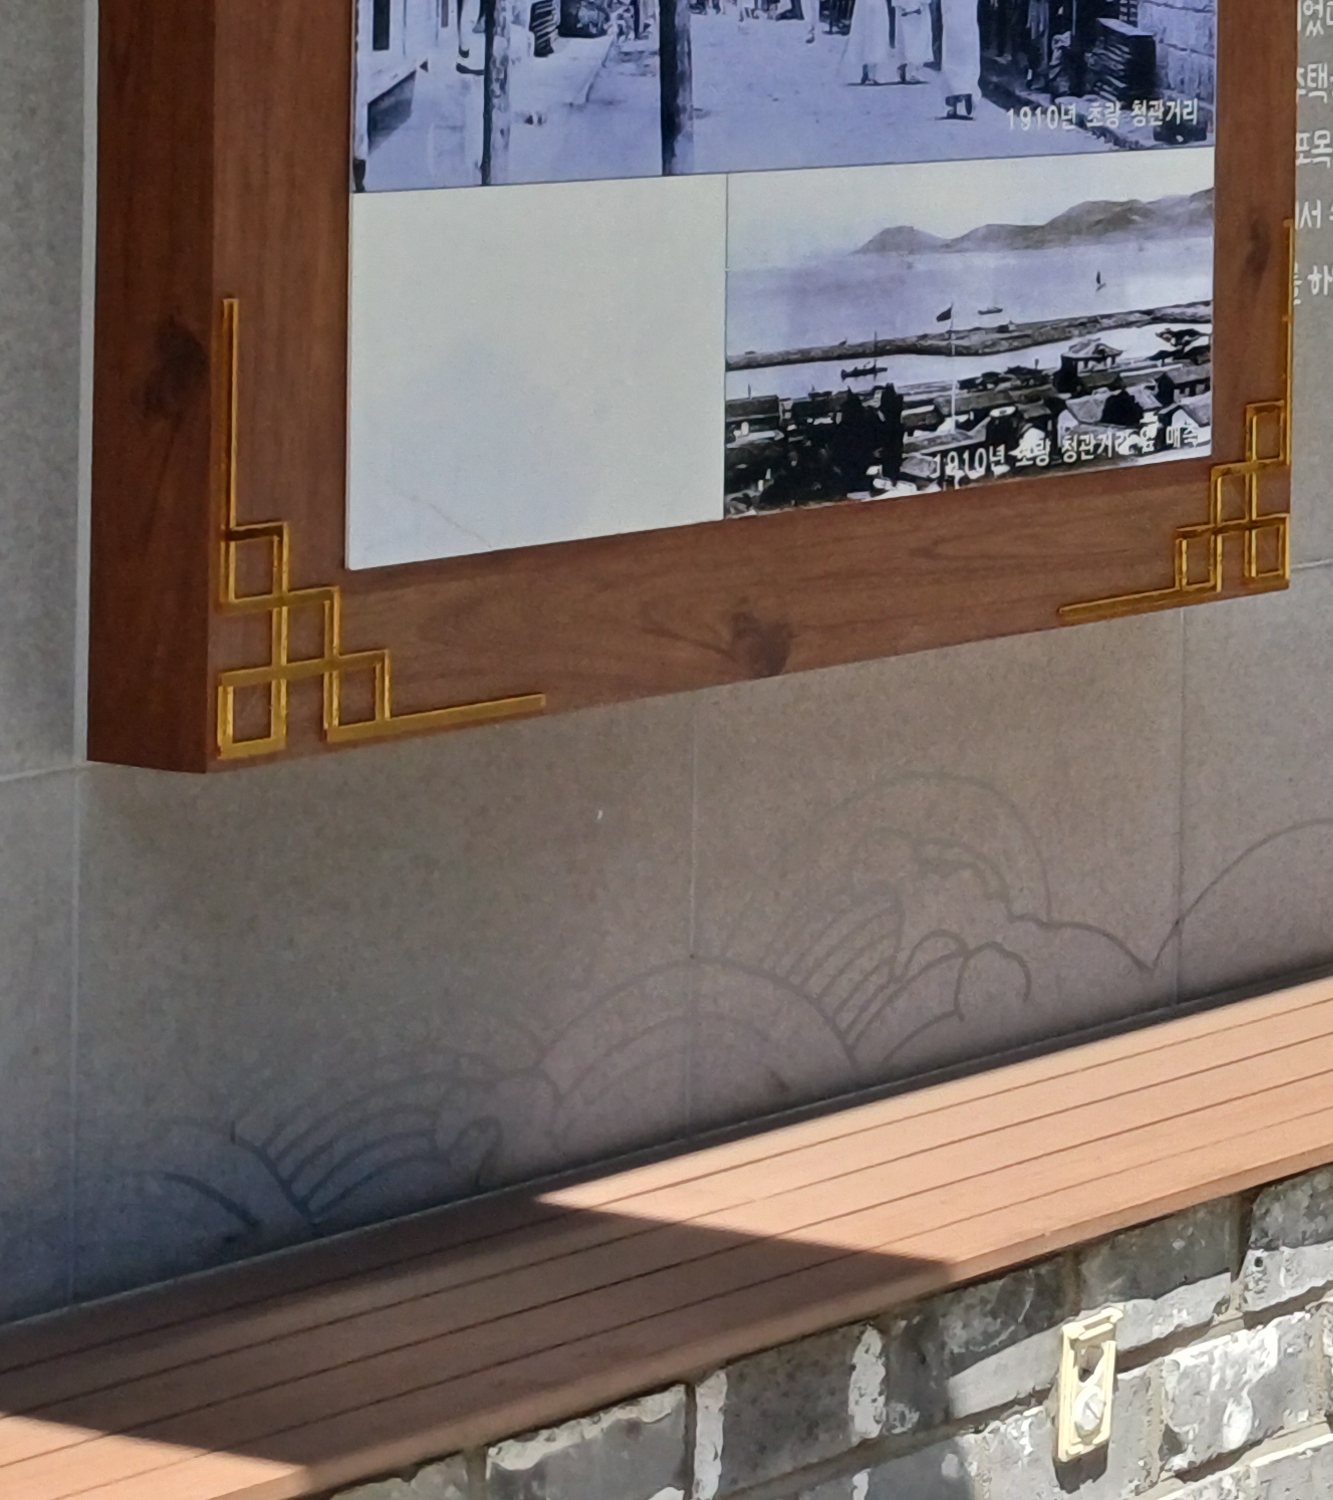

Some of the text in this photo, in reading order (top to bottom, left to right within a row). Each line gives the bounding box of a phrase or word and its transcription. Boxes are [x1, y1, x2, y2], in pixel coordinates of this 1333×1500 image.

[1007, 98, 1199, 130] 1910년 초량 청관거리
[932, 444, 1006, 478] 1910년
